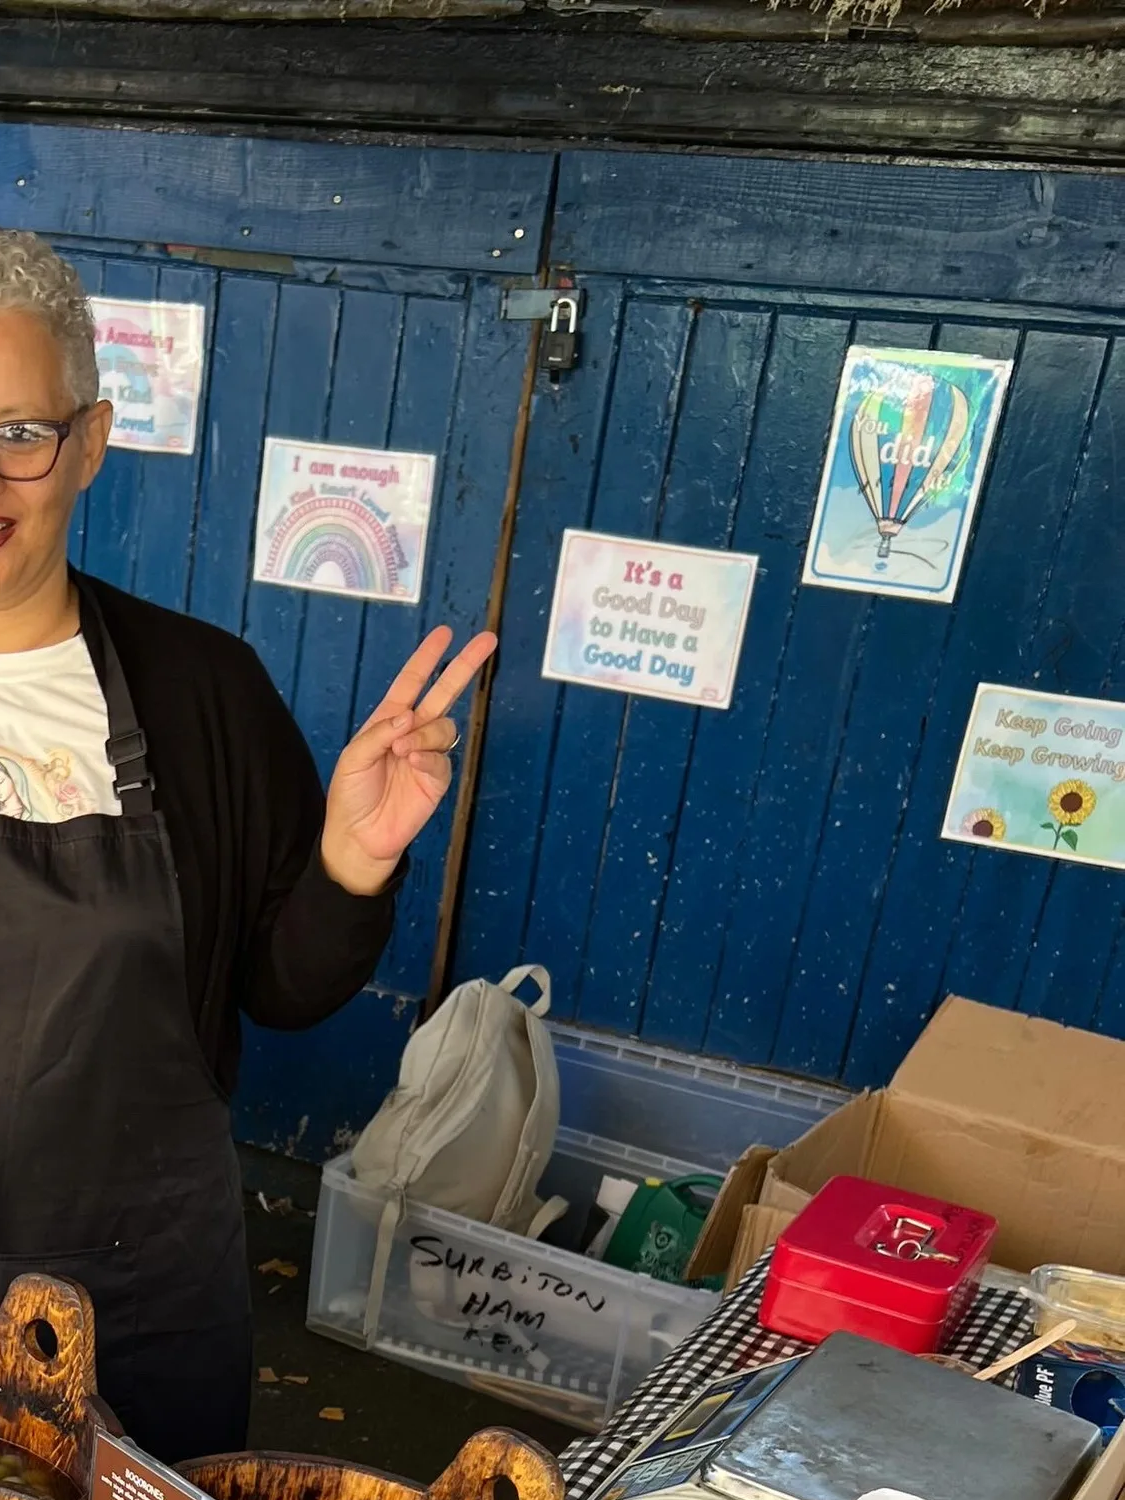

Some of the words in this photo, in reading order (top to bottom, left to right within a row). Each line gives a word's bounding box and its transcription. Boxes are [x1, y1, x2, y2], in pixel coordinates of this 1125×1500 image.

[854, 410, 889, 435] You
[879, 432, 936, 468] did
[292, 455, 301, 472] I
[308, 461, 335, 477] am
[339, 464, 400, 487] enough
[624, 560, 662, 587] It's
[667, 573, 683, 591] a
[592, 586, 654, 616] Good
[657, 597, 708, 630] Day
[589, 616, 613, 638] to
[619, 620, 679, 650] Have
[682, 635, 699, 653] a
[583, 644, 644, 674] Good
[647, 655, 696, 688] Day
[994, 708, 1048, 738] Keep
[1053, 717, 1123, 749] Going
[972, 737, 1025, 767] Keep
[1031, 746, 1125, 782] Growing
